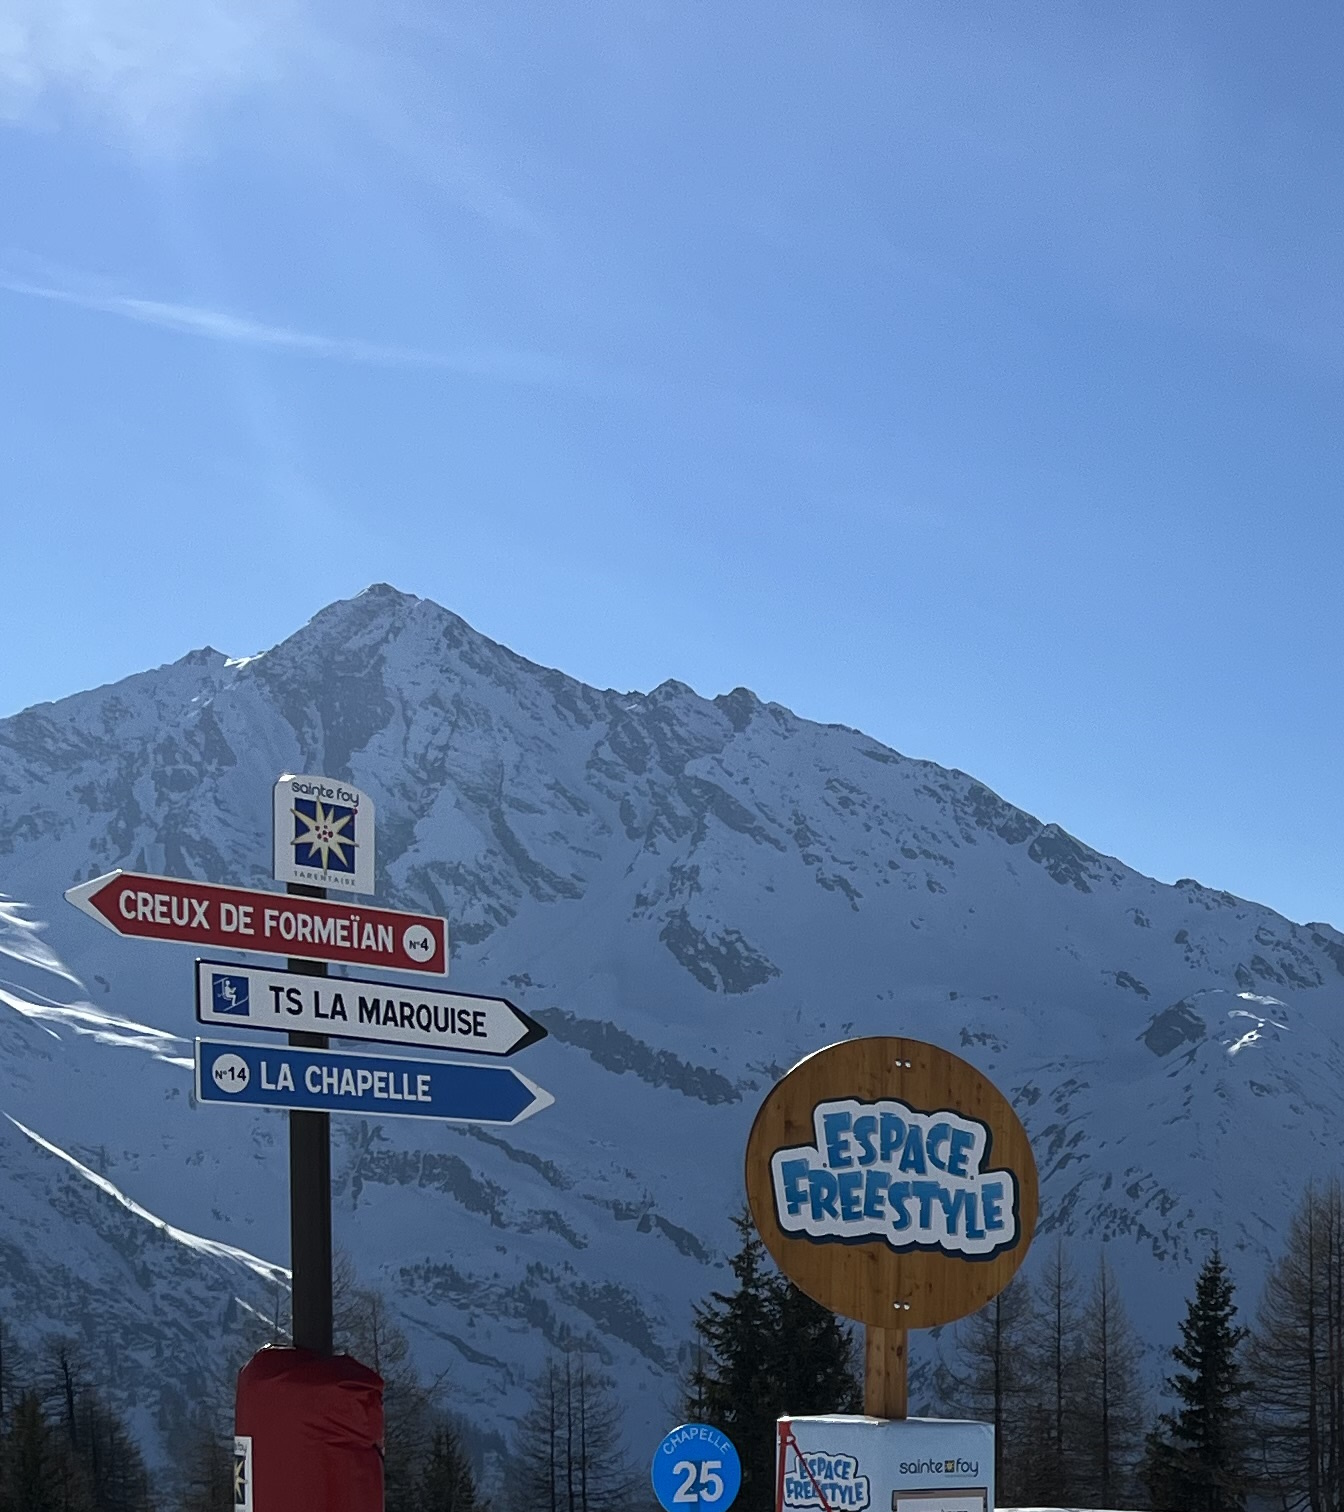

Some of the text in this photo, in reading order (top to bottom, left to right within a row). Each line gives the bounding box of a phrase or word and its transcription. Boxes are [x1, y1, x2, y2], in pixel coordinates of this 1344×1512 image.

[291, 781, 359, 807] sainte foy
[119, 889, 210, 930] CREUX
[220, 902, 255, 935] DE
[264, 908, 394, 953] FORMEÏAN
[269, 985, 487, 1038] TS LA MARQUISE
[260, 1061, 295, 1092] LA
[305, 1065, 432, 1102] CHAPELLE
[823, 1111, 976, 1179] ESPACE
[780, 1158, 1004, 1239] FREESTYLE
[663, 1427, 731, 1455] CHAPELLE
[672, 1460, 724, 1503] 25
[899, 1457, 979, 1477] sainte foy
